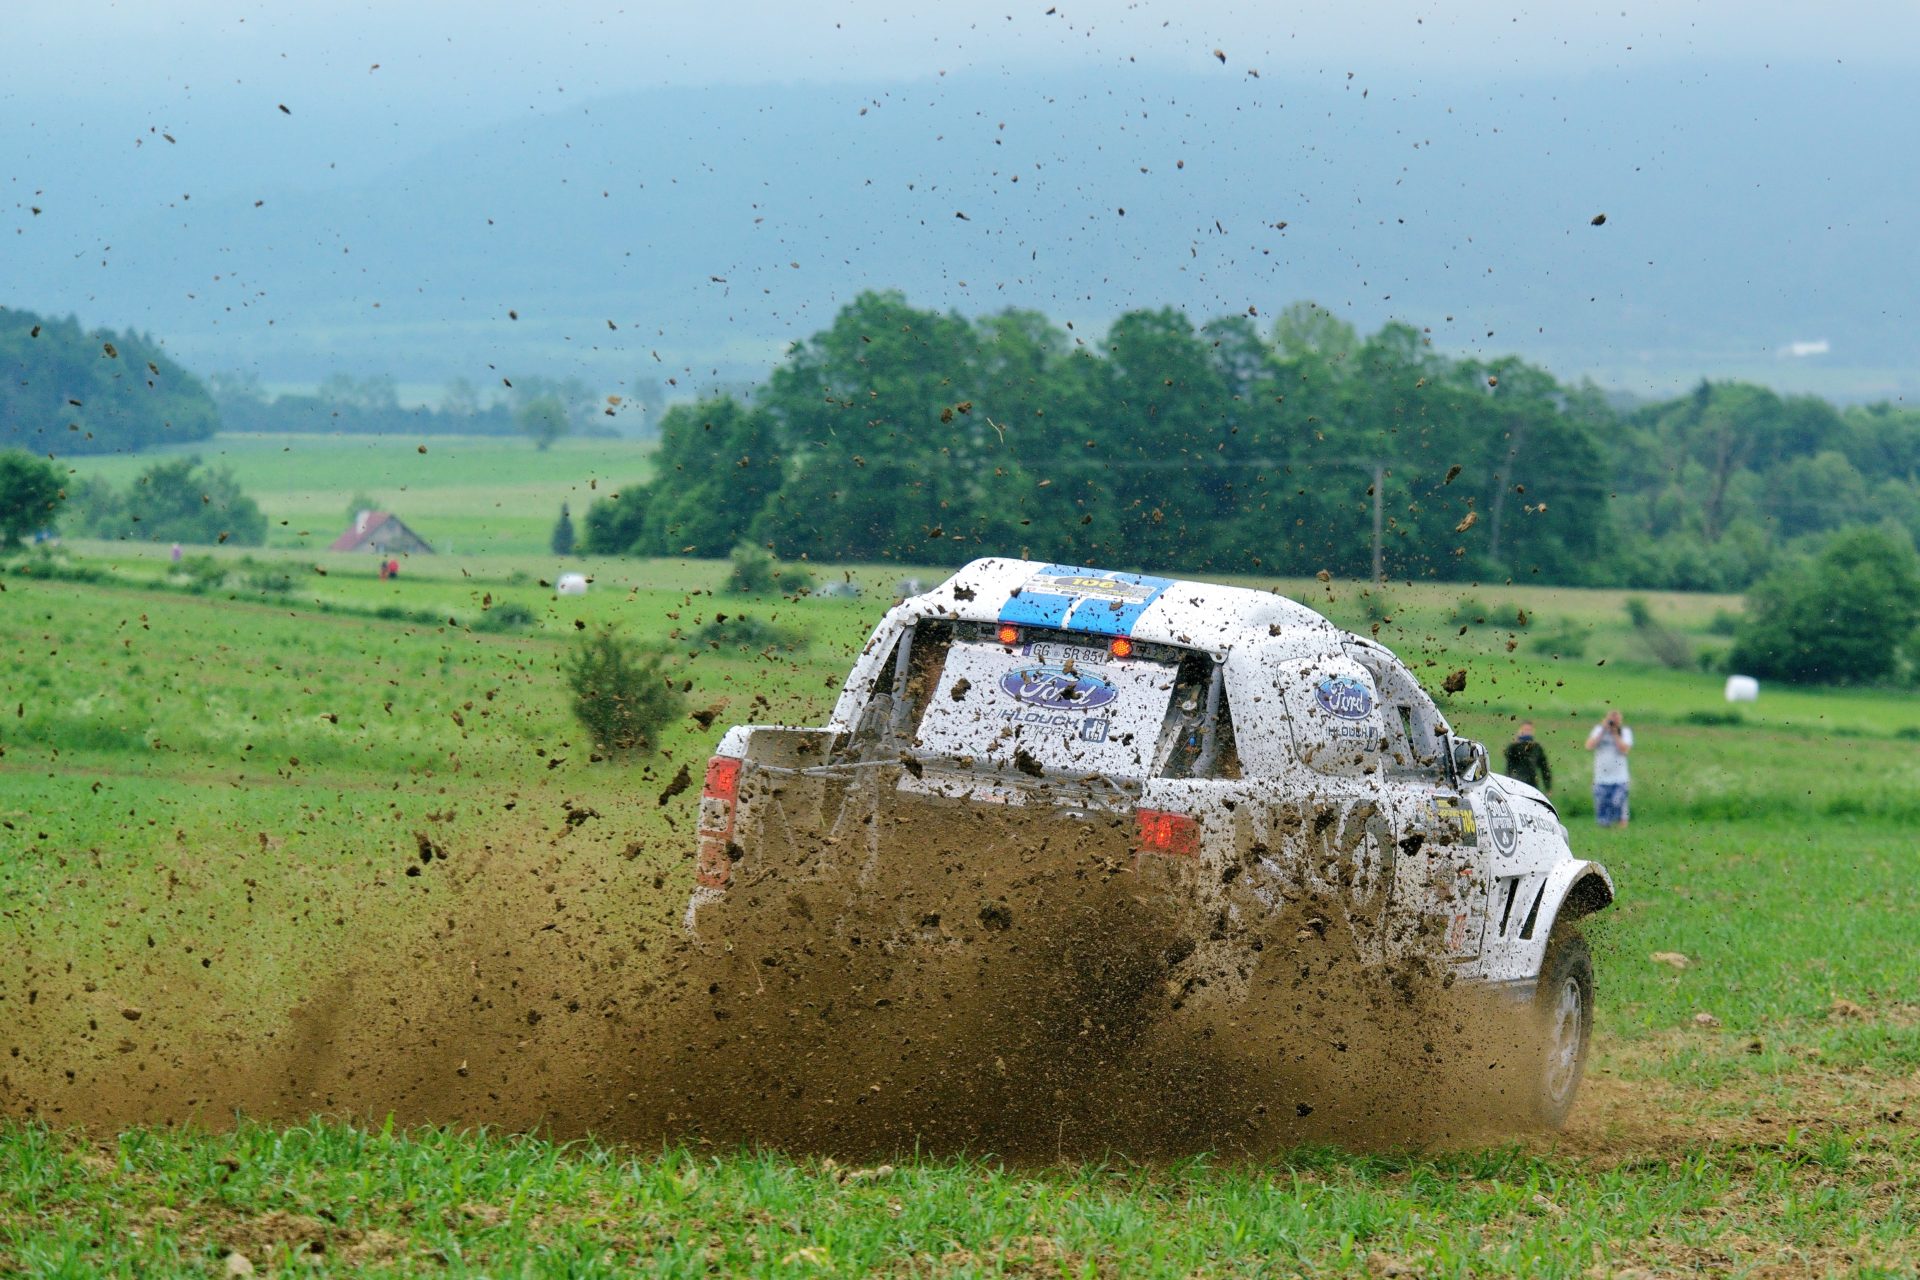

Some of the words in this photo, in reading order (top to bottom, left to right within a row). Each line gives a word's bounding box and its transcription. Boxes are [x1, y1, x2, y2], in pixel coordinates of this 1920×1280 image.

[1072, 578, 1115, 588] 106
[1033, 643, 1050, 657] GG
[1063, 647, 1080, 660] SR
[1082, 650, 1105, 663] 851
[1019, 671, 1099, 705] Ford
[1329, 680, 1364, 713] Ford
[1000, 709, 1079, 728] HLOUCH
